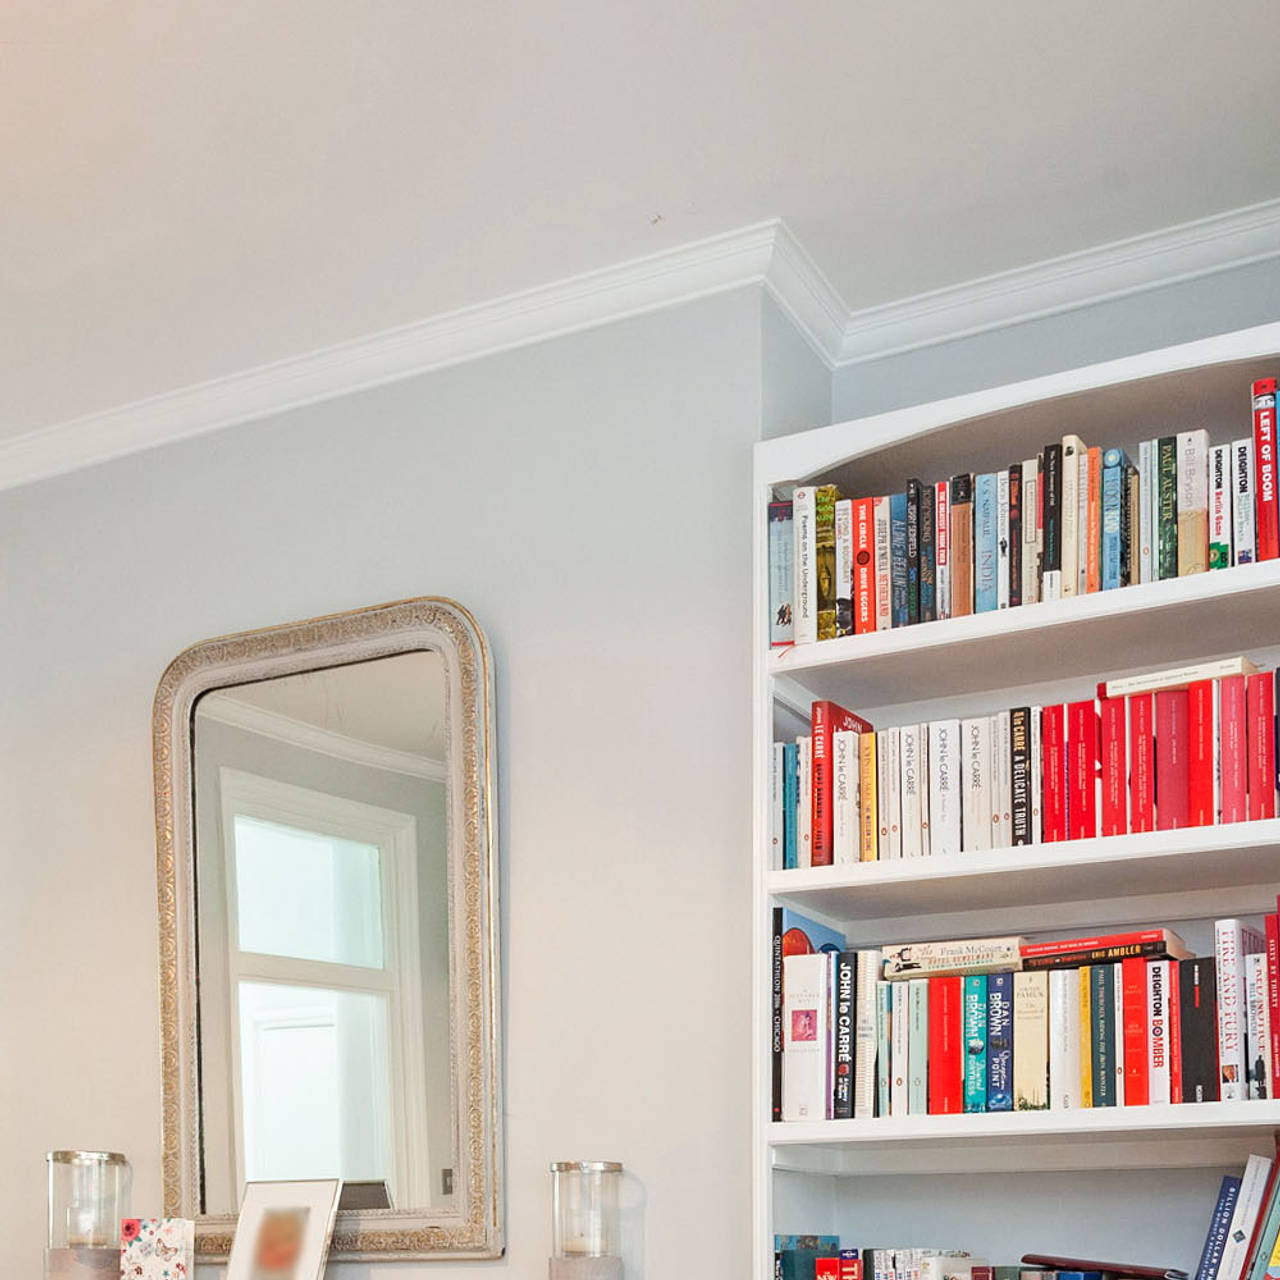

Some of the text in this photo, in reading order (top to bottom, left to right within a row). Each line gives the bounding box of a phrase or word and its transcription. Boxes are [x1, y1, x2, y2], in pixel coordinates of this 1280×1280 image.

[1214, 448, 1223, 490] DEIGHTON
[1237, 446, 1248, 494] DEIGHTON
[1259, 411, 1274, 503] LEFT OF BOOM
[1162, 444, 1174, 522] PAUL AUSTER
[838, 962, 853, 999] JOHN
[1222, 972, 1238, 1007] AND
[989, 993, 1002, 1037] BROWN
[1001, 1001, 1011, 1027] DAN
[1152, 966, 1165, 1069] DEIGHTON BOMBER
[991, 1057, 1001, 1088] POINT
